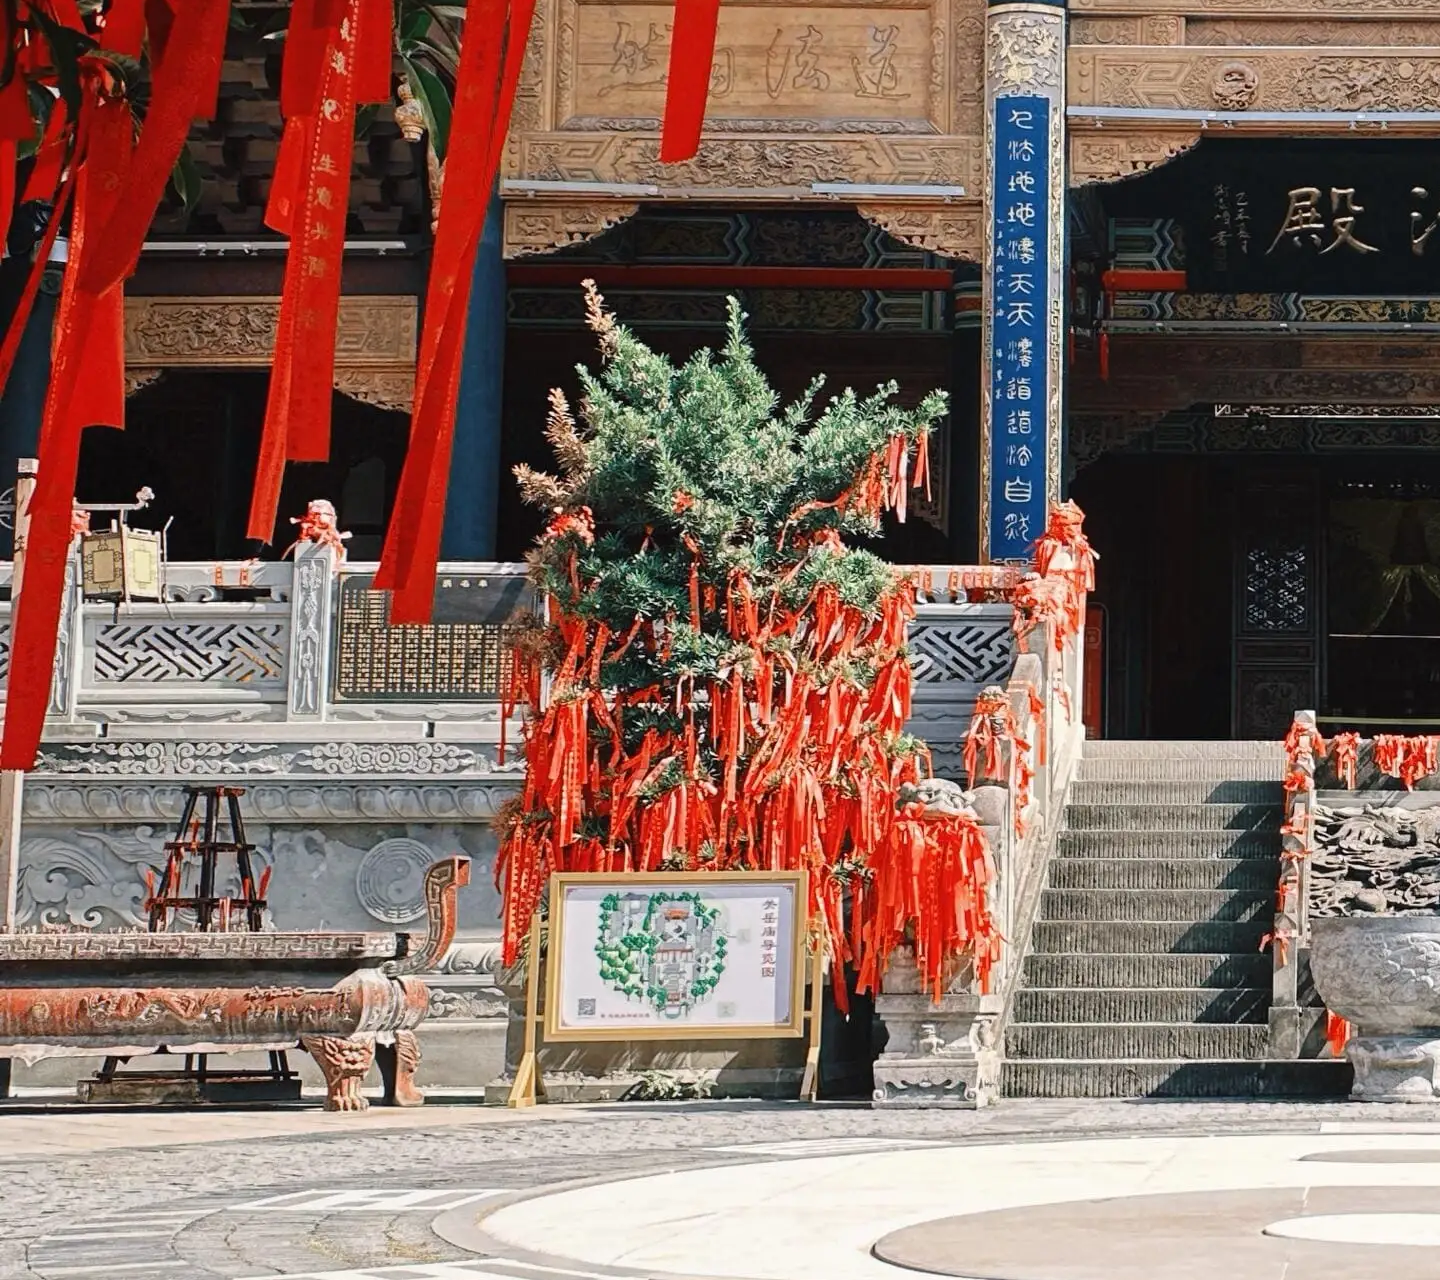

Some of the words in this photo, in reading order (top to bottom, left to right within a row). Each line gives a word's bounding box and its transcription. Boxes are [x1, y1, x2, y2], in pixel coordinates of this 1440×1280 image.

[761, 899, 778, 978] 关岳庙导览图
